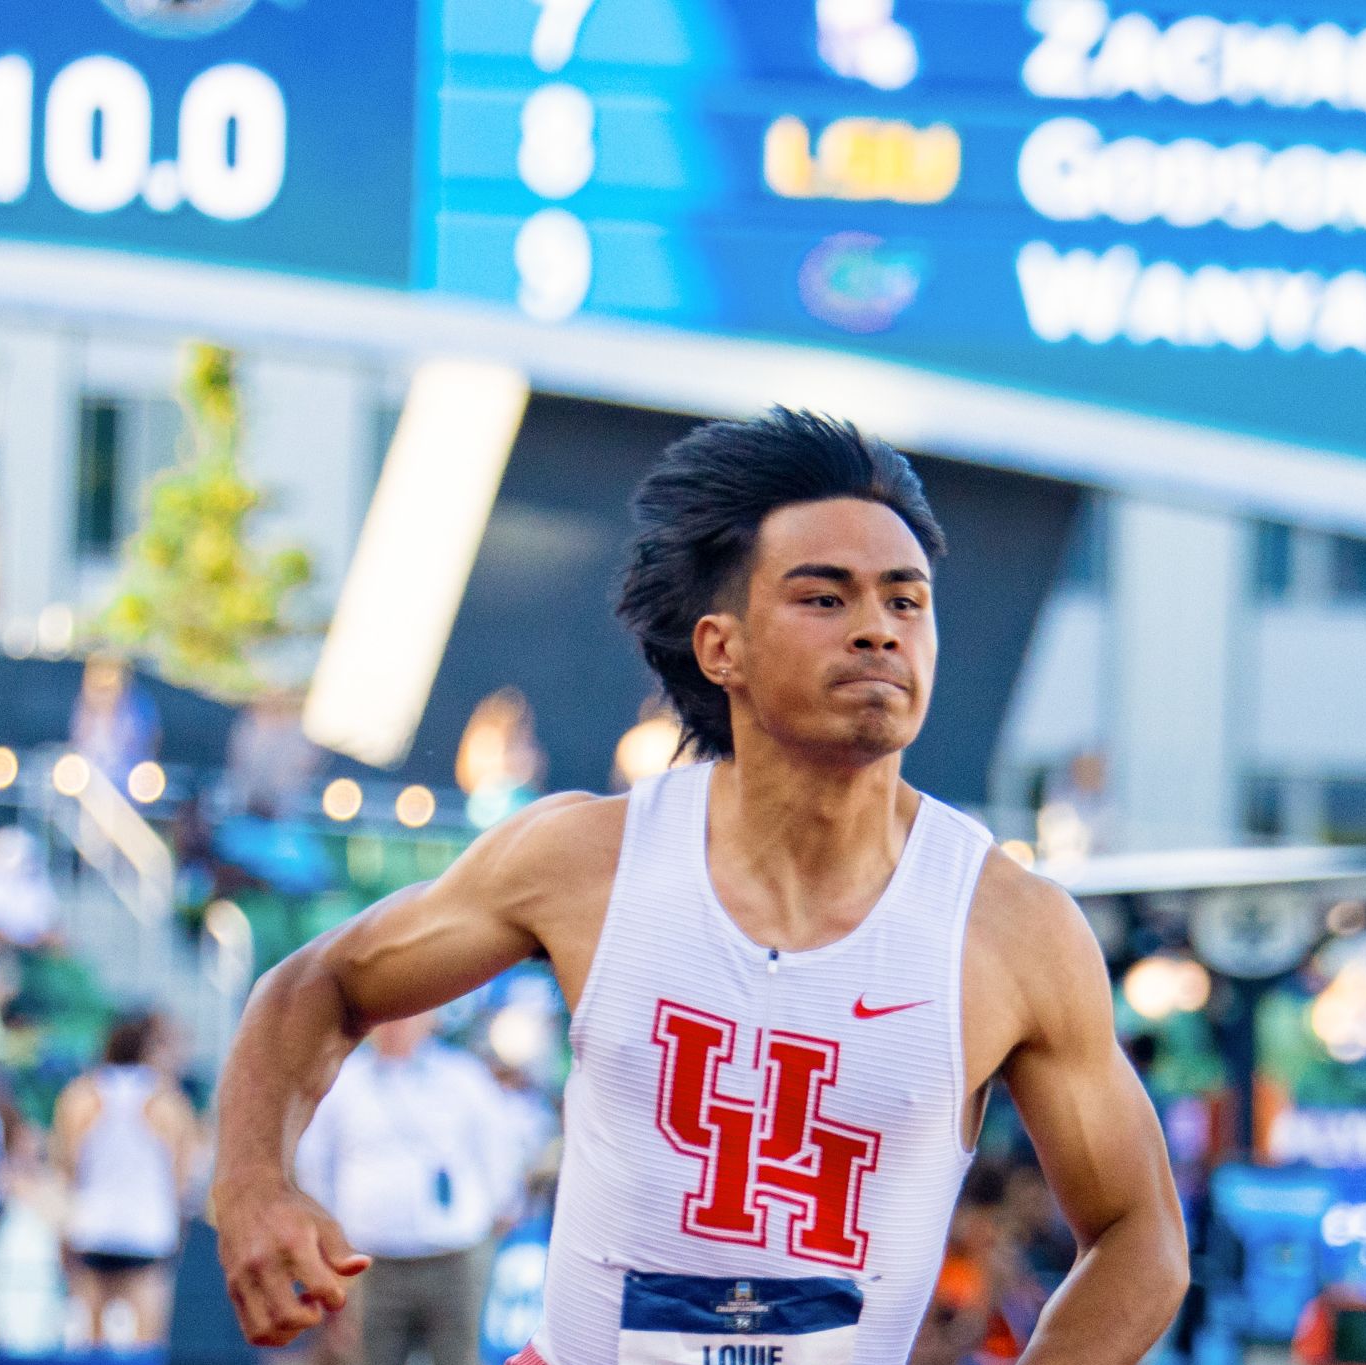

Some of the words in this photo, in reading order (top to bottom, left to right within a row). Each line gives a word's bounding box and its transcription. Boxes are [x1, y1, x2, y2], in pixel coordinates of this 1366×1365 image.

[517, 83, 596, 200] 8
[515, 208, 593, 322] 9
[651, 998, 883, 1270] UH
